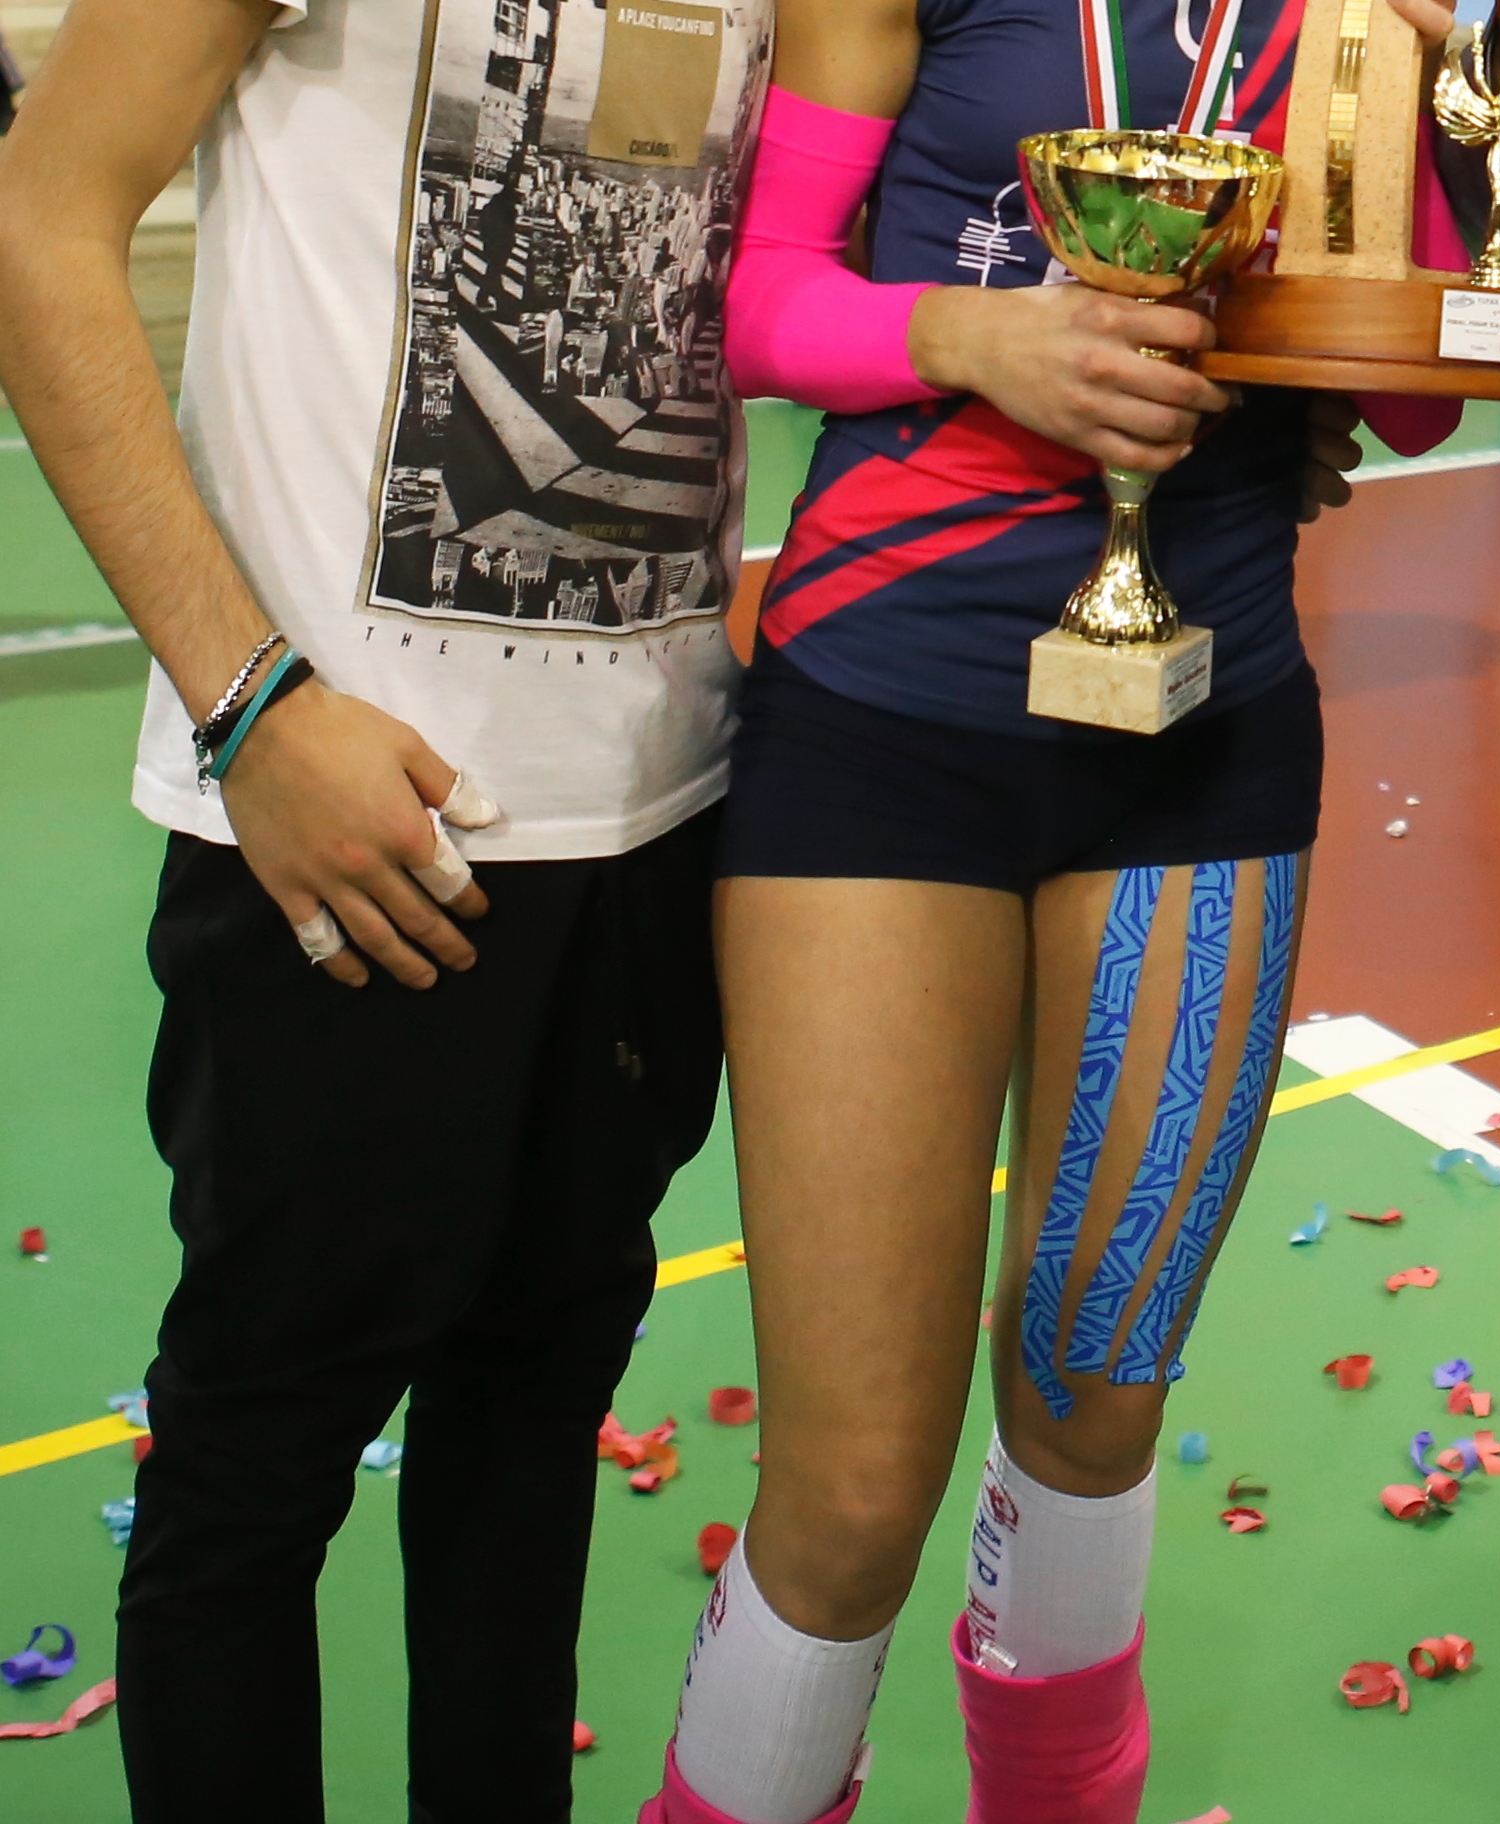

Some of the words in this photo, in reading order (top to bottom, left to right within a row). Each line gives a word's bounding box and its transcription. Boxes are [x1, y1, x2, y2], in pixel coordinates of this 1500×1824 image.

[627, 9, 656, 29] PLACE
[657, 13, 675, 32] YOU
[365, 626, 449, 656] THE
